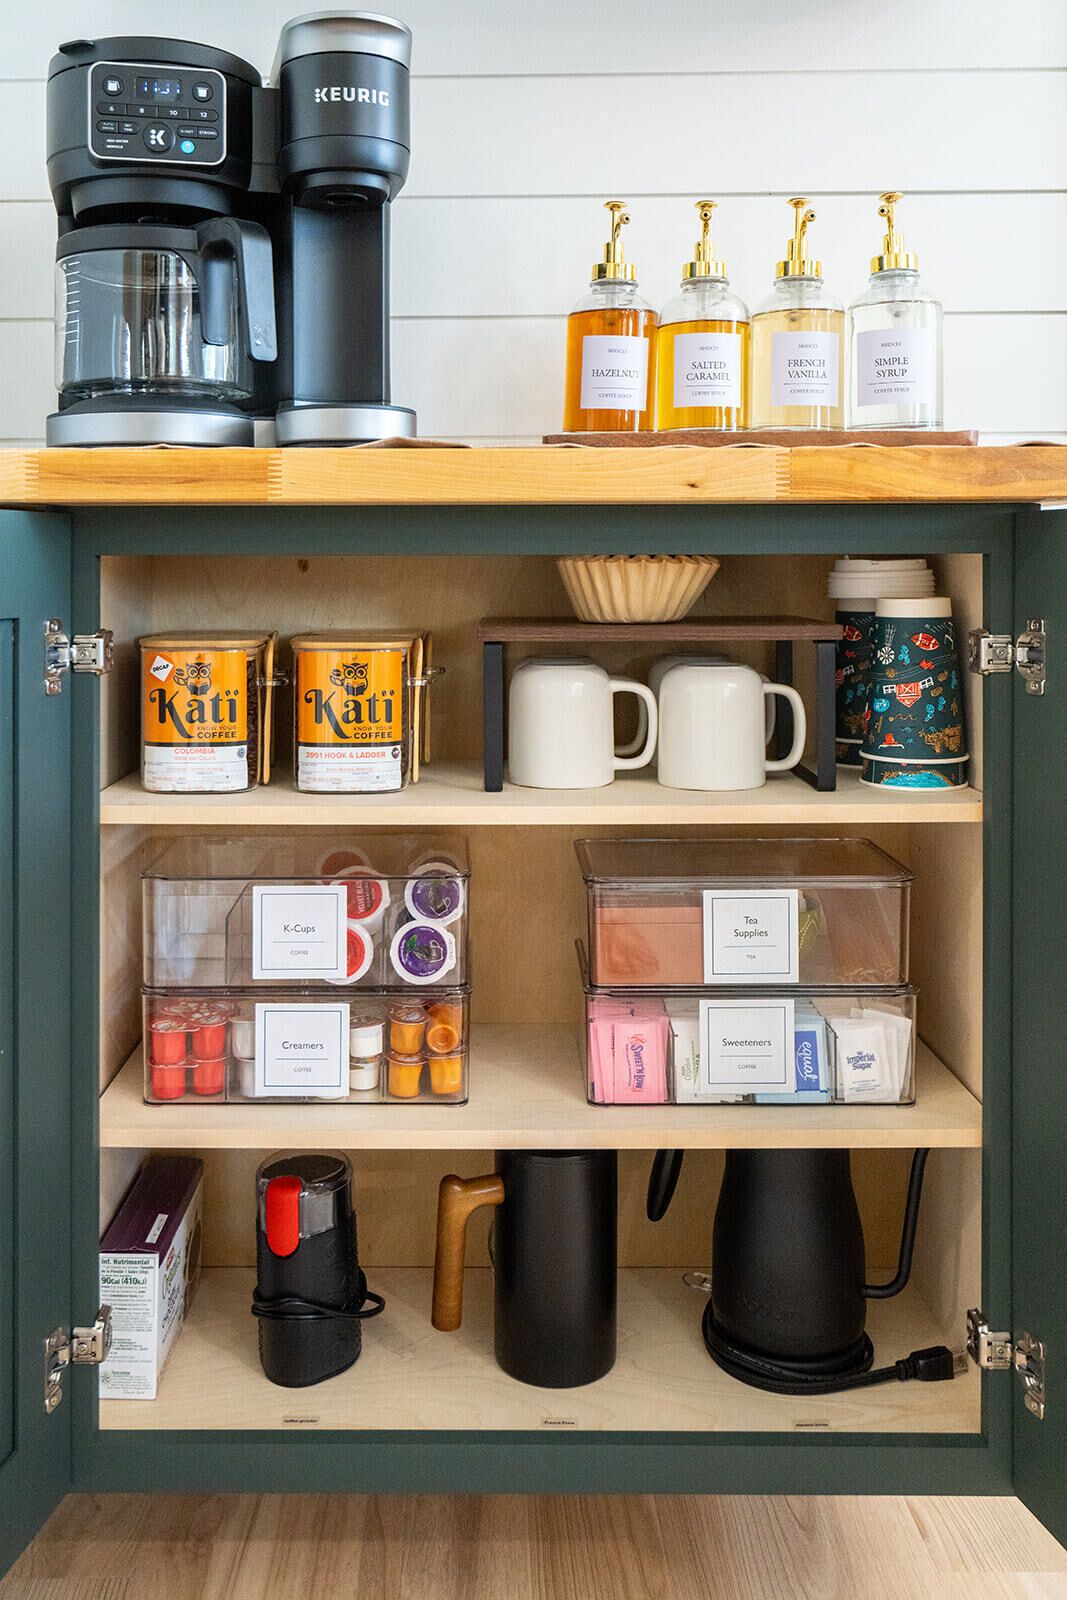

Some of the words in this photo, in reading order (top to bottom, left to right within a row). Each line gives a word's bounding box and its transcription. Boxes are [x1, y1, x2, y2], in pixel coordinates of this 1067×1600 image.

[314, 86, 390, 107] KEURIG
[691, 360, 727, 370] SALTED
[787, 359, 826, 367] FRENCH
[874, 356, 909, 367] SIMPLE
[591, 368, 640, 378] HAZELNUT
[686, 372, 731, 381] CARAMEL
[787, 370, 827, 379] VANILLA
[876, 368, 908, 378] SYRUP
[152, 663, 170, 673] DECAF
[197, 731, 237, 739] COFFEE
[324, 751, 346, 759] HOOK
[348, 751, 354, 759] &
[355, 751, 386, 759] LADDER
[743, 915, 758, 925] Tea
[283, 924, 316, 934] K-Cups
[733, 928, 769, 939] Supplies
[281, 1040, 324, 1050] Creamers
[721, 1038, 772, 1047] Sweeteners
[798, 1041, 818, 1081] equal
[846, 1053, 876, 1064] Imperial
[852, 1062, 873, 1071] Sugar
